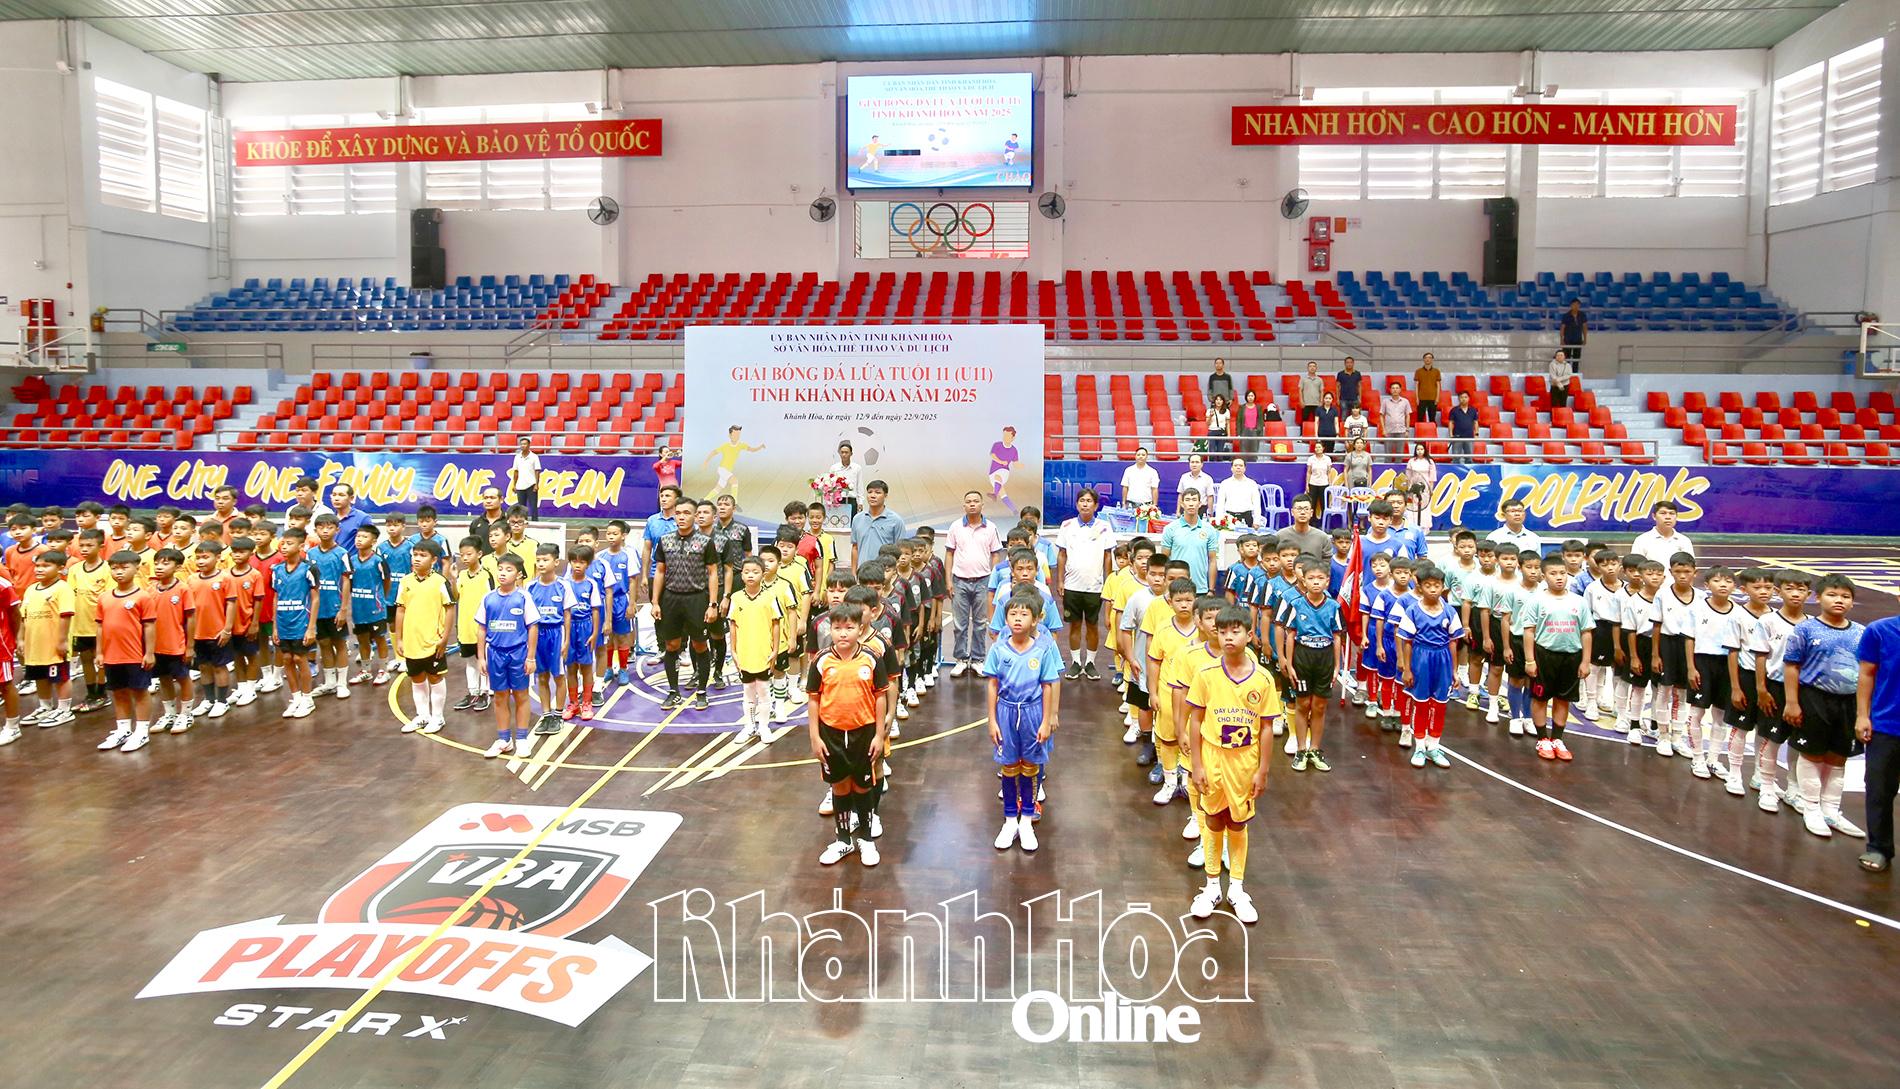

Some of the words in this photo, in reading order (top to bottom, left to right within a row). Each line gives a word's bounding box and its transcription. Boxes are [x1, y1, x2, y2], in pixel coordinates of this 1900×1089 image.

[1244, 113, 1340, 136] NHANH
[1347, 109, 1405, 136] HƠN
[1428, 112, 1485, 135] CAO
[1491, 108, 1551, 135] HƠN
[1572, 112, 1656, 142] MẠNH
[1662, 109, 1724, 136] HƠN
[247, 136, 301, 160] KHỎE
[306, 131, 333, 158] ĐỂ
[337, 133, 378, 157] XÂY
[383, 134, 439, 160] DỰNG
[444, 130, 471, 154] VÀ
[476, 129, 519, 154] BẢO
[524, 128, 550, 157] VỆ
[555, 123, 584, 152] TỔ
[589, 122, 650, 154] QUỐC
[786, 334, 806, 342] BAN
[860, 344, 888, 352] THAO
[908, 344, 921, 352] DU
[924, 344, 949, 354] LỊCH
[772, 362, 818, 381] BÓNG
[823, 362, 846, 380] ĐÁ
[851, 362, 885, 380] LỨA
[889, 363, 930, 380] TUỔI
[937, 367, 948, 380] 11
[955, 367, 993, 383] (U11)
[795, 384, 854, 402] KHÁNH
[860, 384, 896, 402] HÒA
[901, 384, 939, 402] NĂM
[944, 388, 977, 402] 2025
[871, 411, 884, 420] đến
[885, 414, 902, 422] ngày
[102, 459, 162, 501] ONE
[167, 459, 229, 501] CITY
[244, 460, 305, 504] ONE
[432, 462, 496, 507] ONE
[1430, 469, 1491, 526] OF
[1494, 468, 1710, 527] DOLPHINS
[49, 665, 58, 678] 8
[540, 818, 646, 837] MSB
[428, 855, 585, 891] VBA
[198, 932, 597, 1003] PLAYOFFS
